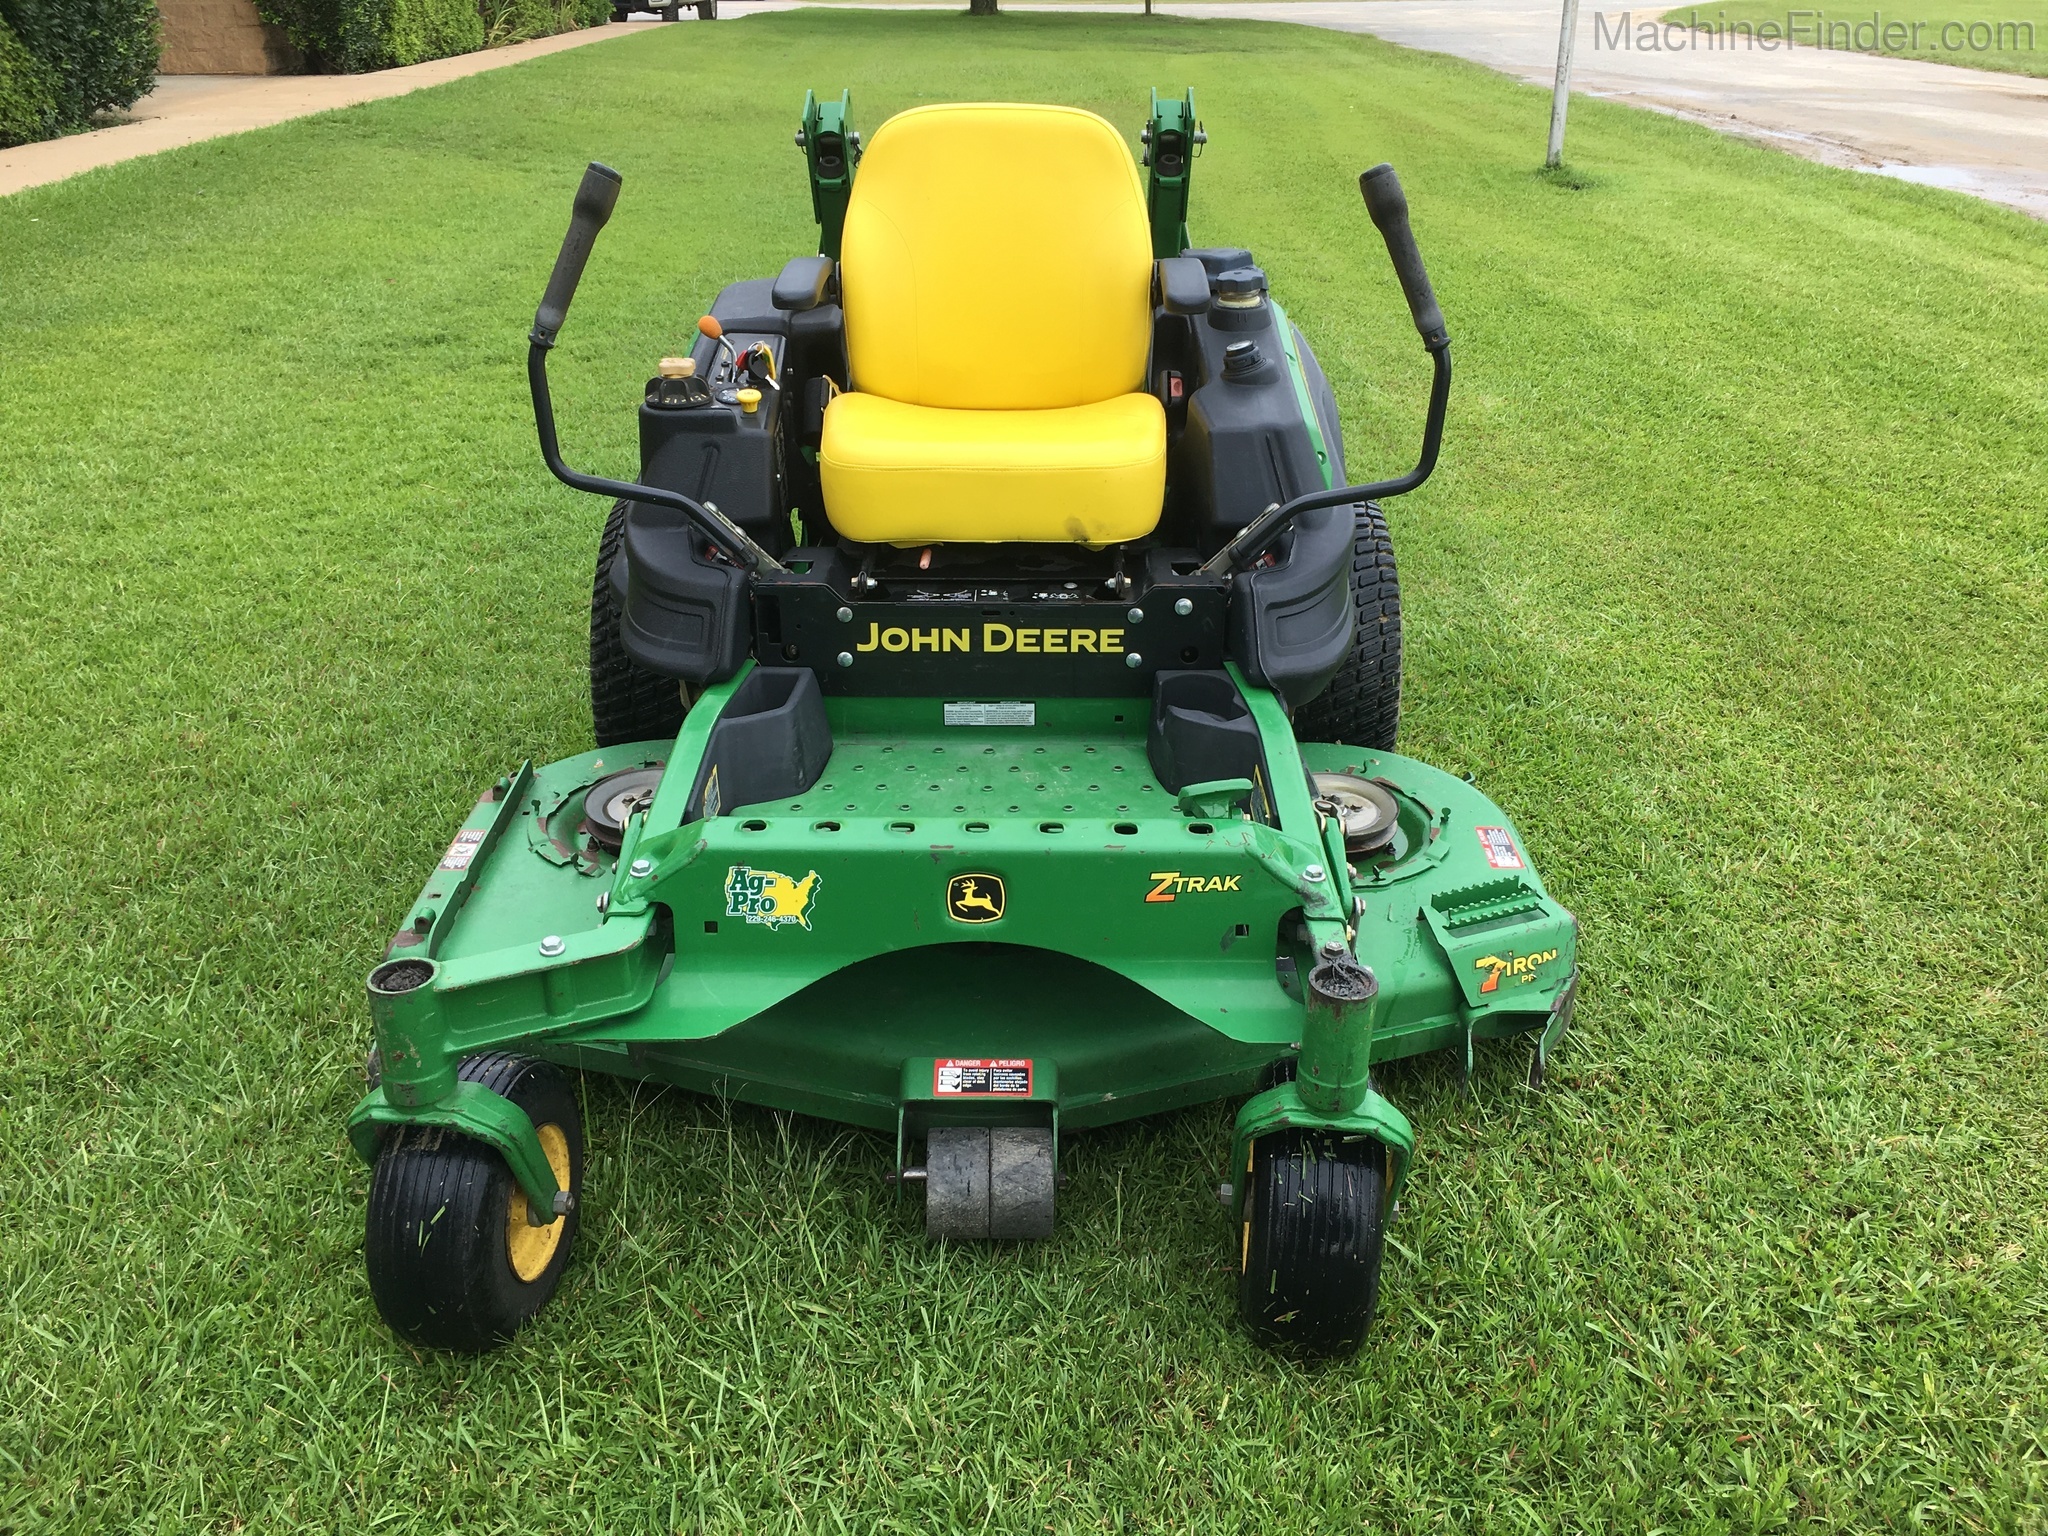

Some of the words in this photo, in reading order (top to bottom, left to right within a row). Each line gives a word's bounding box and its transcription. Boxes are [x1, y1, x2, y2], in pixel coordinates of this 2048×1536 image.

[856, 622, 970, 652] JOHN
[983, 623, 1125, 653] DEERE
[728, 868, 775, 896] Ag-
[728, 891, 776, 914] Pro
[955, 1059, 981, 1067] DANGER
[998, 1059, 1025, 1067] PELIGRO
